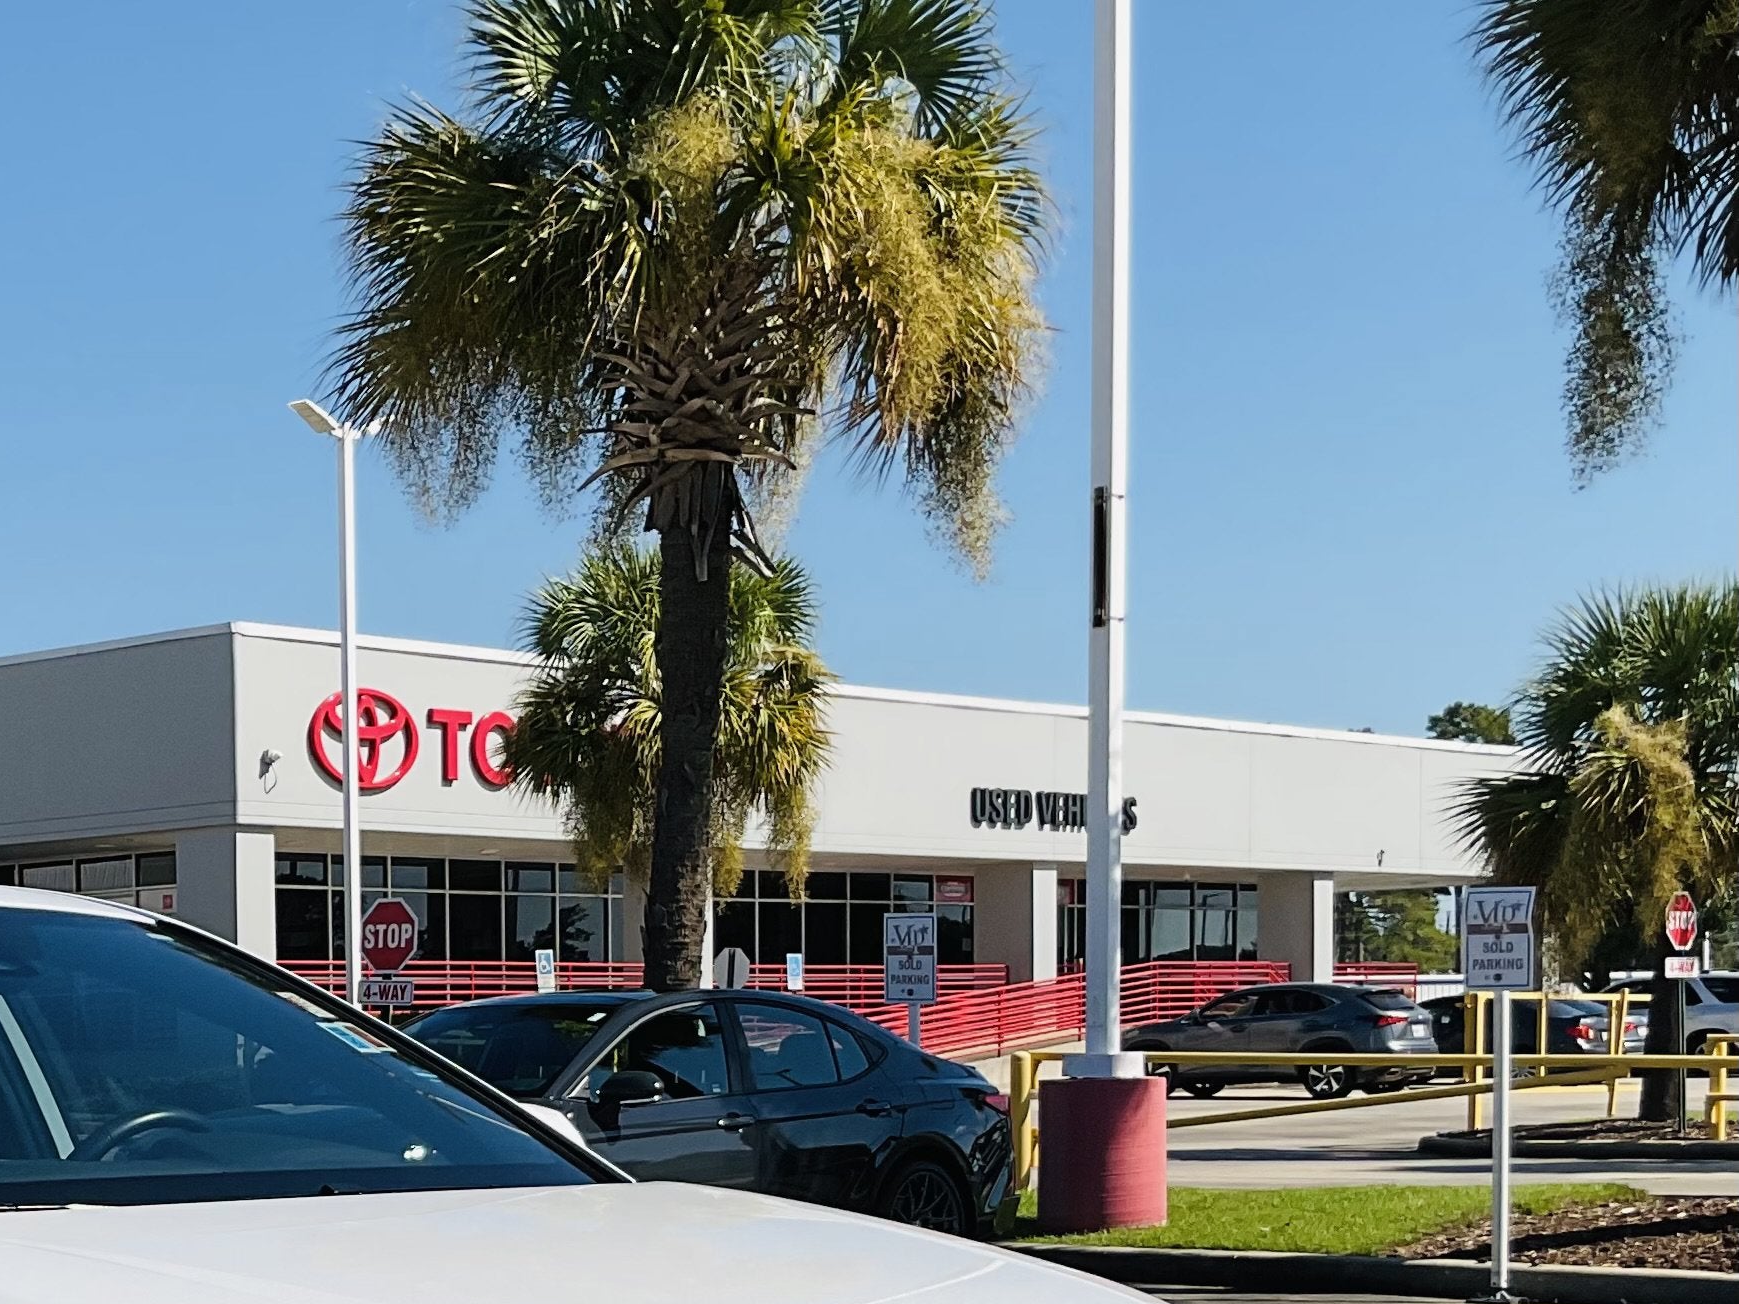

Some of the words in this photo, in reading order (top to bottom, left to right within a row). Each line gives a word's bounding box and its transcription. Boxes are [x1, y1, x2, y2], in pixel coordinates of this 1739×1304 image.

[971, 787, 1033, 829] USED
[1035, 791, 1138, 836] VEHIS
[1668, 910, 1695, 931] STOP
[364, 923, 412, 949] STOP
[1483, 942, 1514, 953] SOLD
[899, 960, 922, 970] SOLD
[1472, 957, 1524, 970] PARKING
[890, 975, 930, 985] PARKING
[363, 984, 408, 1001] 4-WAY
